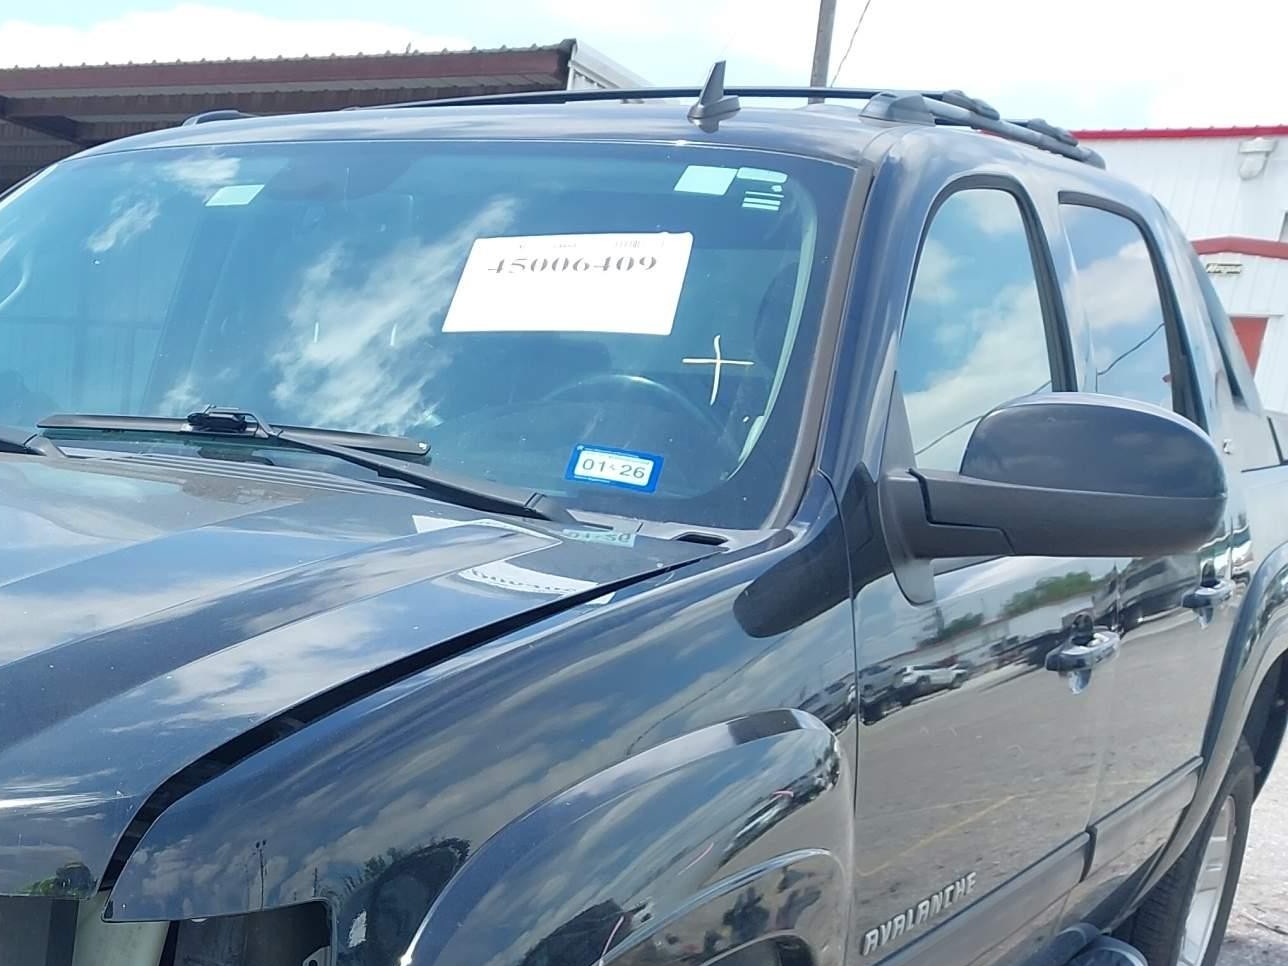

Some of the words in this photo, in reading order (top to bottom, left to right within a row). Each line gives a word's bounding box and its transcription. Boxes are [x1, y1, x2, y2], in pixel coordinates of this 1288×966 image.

[487, 256, 657, 274] 45006409
[619, 464, 646, 479] 26
[860, 871, 977, 956] AVALANCHE
